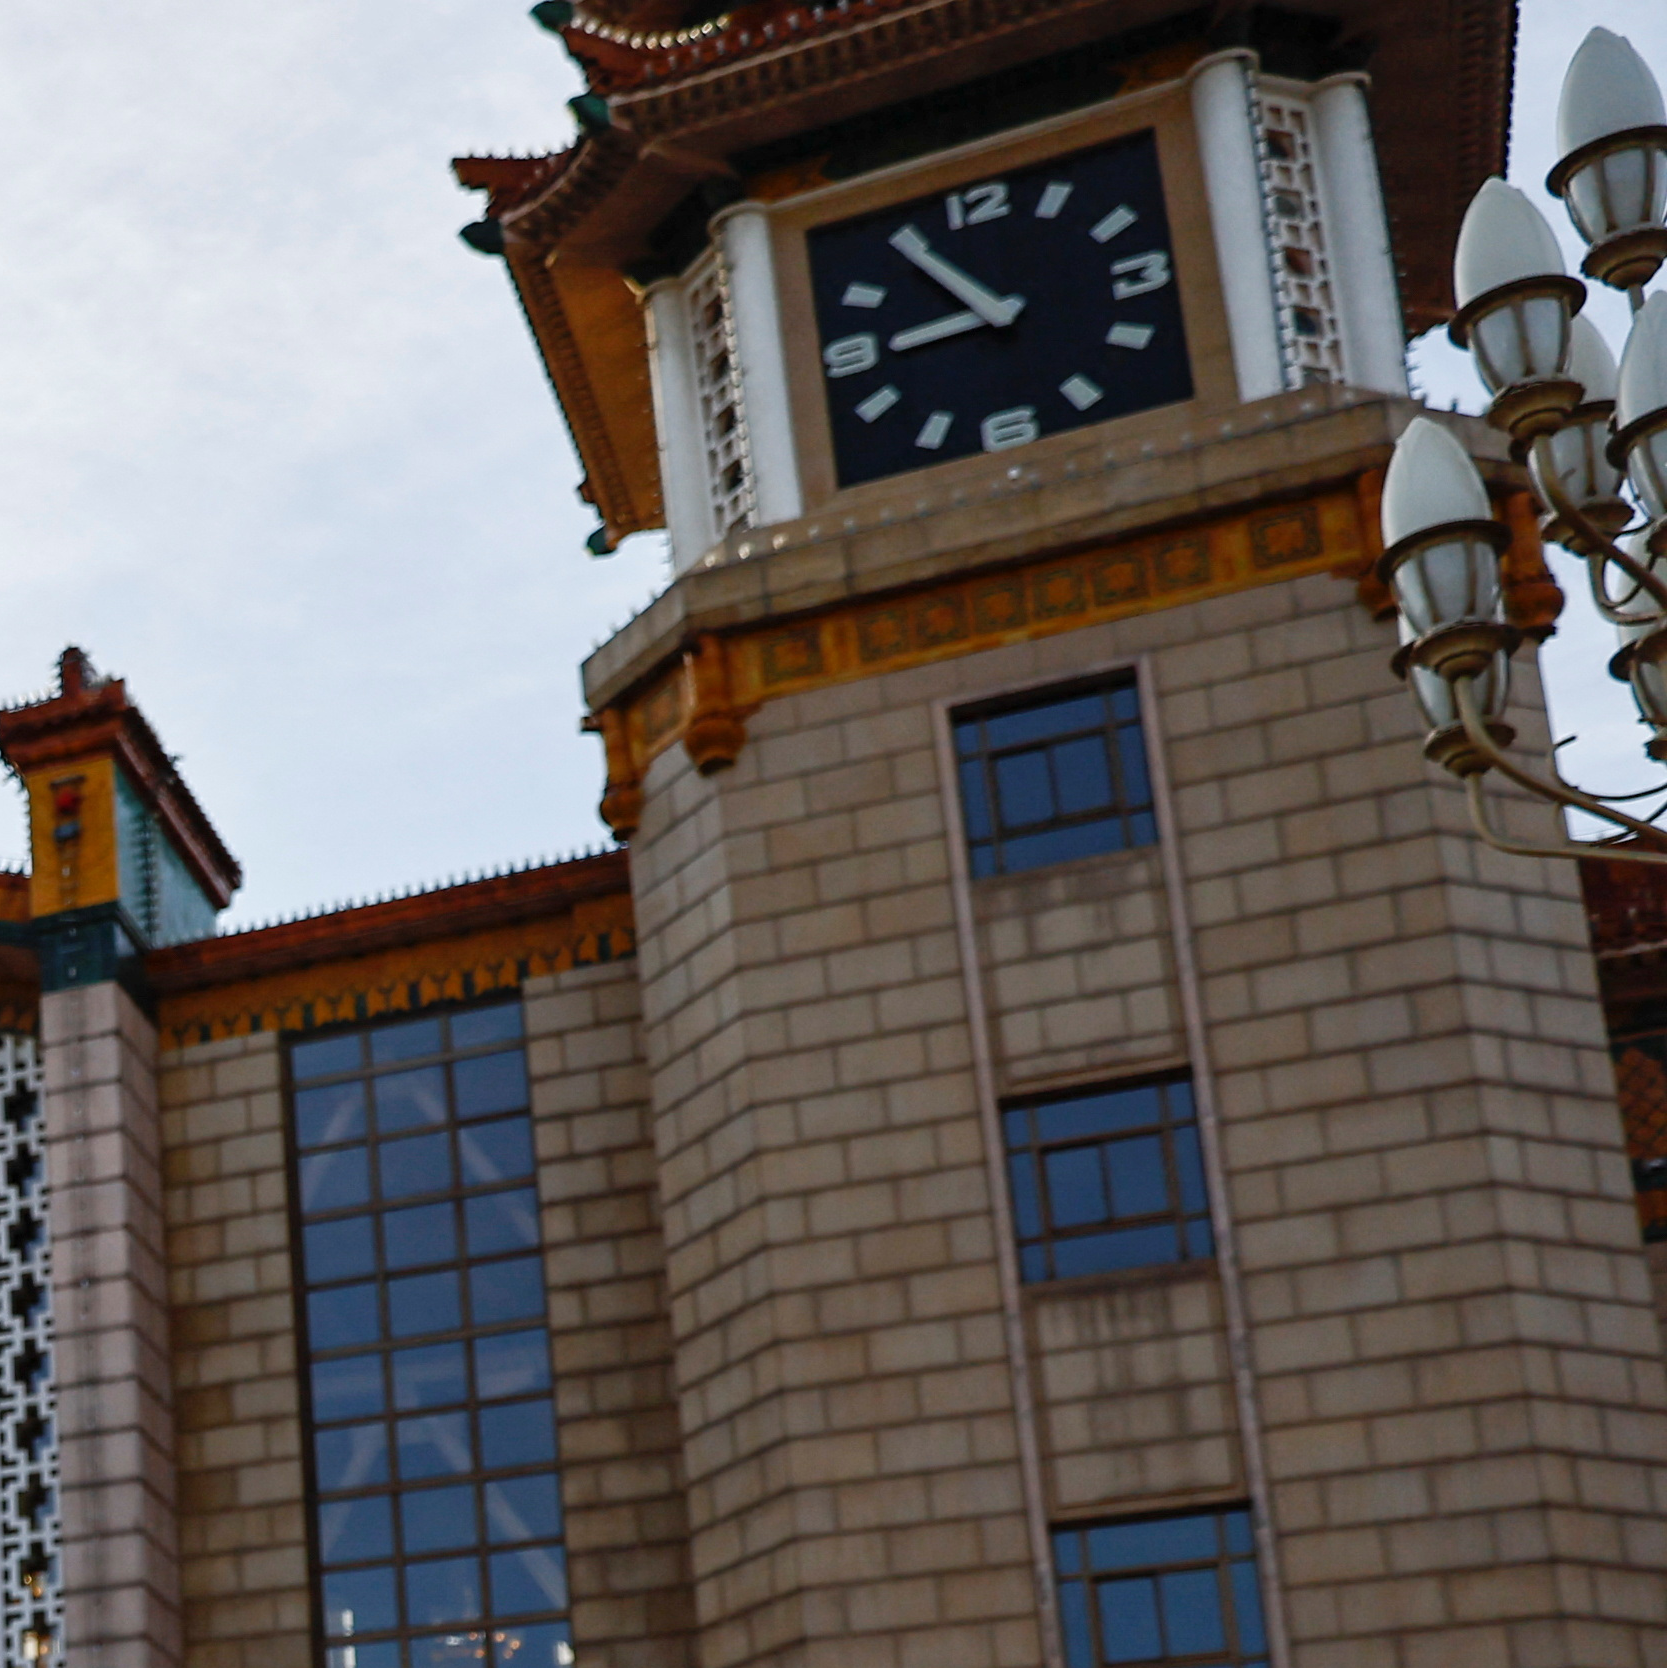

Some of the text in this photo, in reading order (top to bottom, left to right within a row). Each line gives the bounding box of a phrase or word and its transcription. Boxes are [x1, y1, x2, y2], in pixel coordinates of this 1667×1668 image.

[946, 181, 1011, 230] 12
[1110, 250, 1168, 299] 3
[823, 332, 879, 378] 9
[980, 406, 1039, 452] 6
